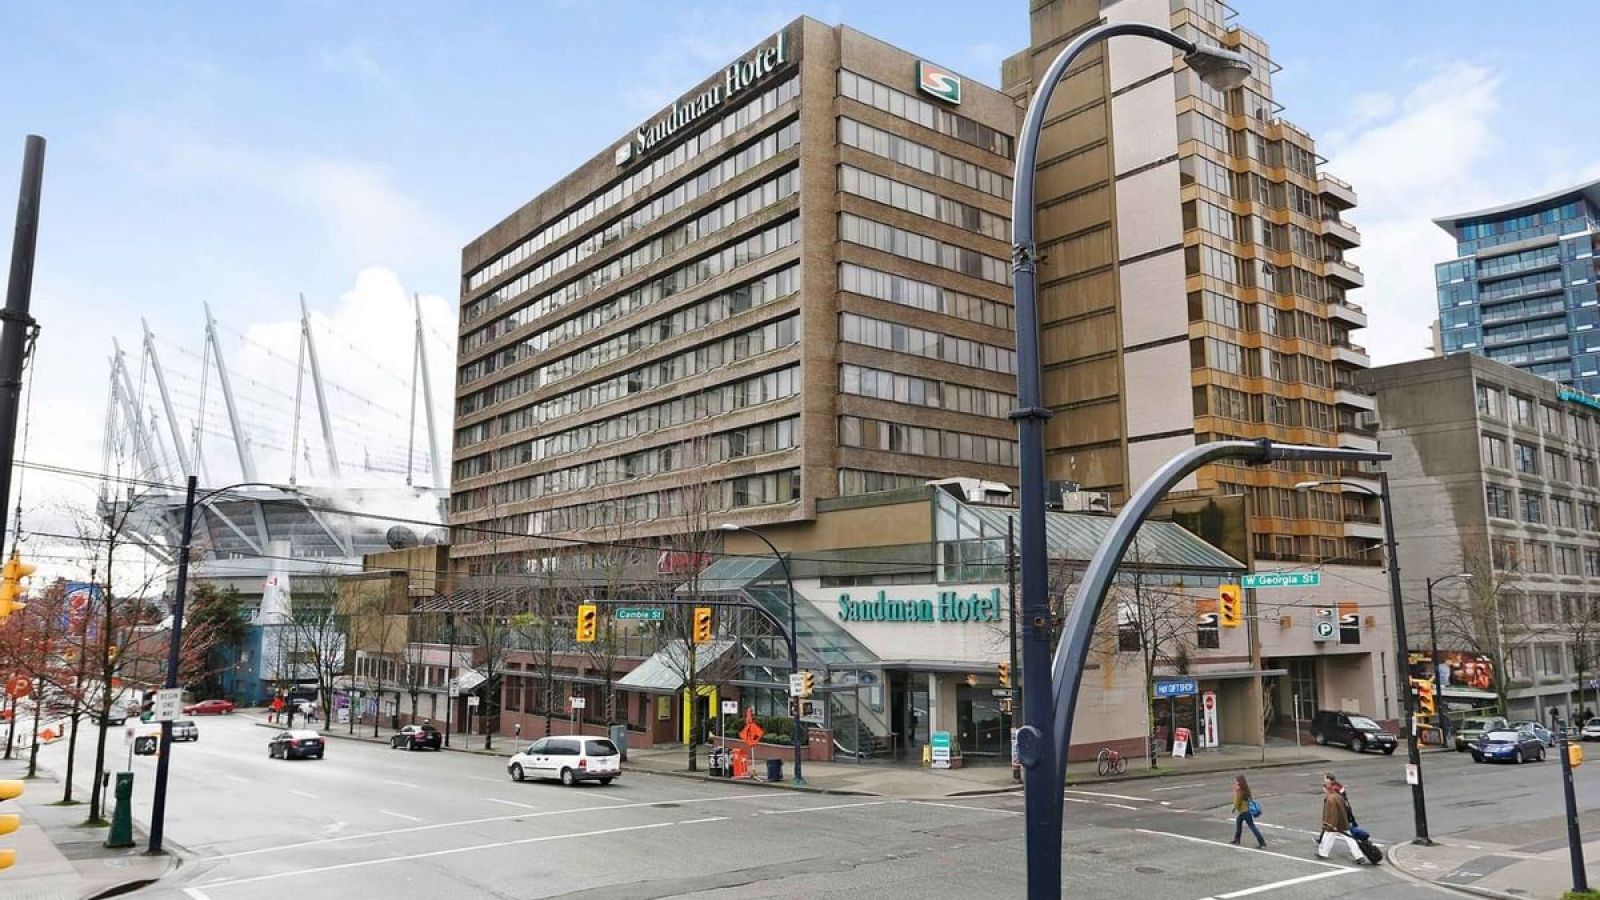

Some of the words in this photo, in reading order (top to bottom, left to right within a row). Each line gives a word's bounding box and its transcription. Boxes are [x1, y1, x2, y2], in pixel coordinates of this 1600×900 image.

[636, 85, 724, 156] Sandman
[725, 31, 787, 98] Hotel
[1247, 577, 1256, 585] W
[1259, 575, 1298, 586] Georgia
[1302, 573, 1314, 584] St
[838, 590, 934, 622] Sandman
[937, 587, 1001, 622] Hotel
[619, 610, 649, 618] Cambie
[651, 610, 661, 618] St
[1320, 623, 1331, 636] P
